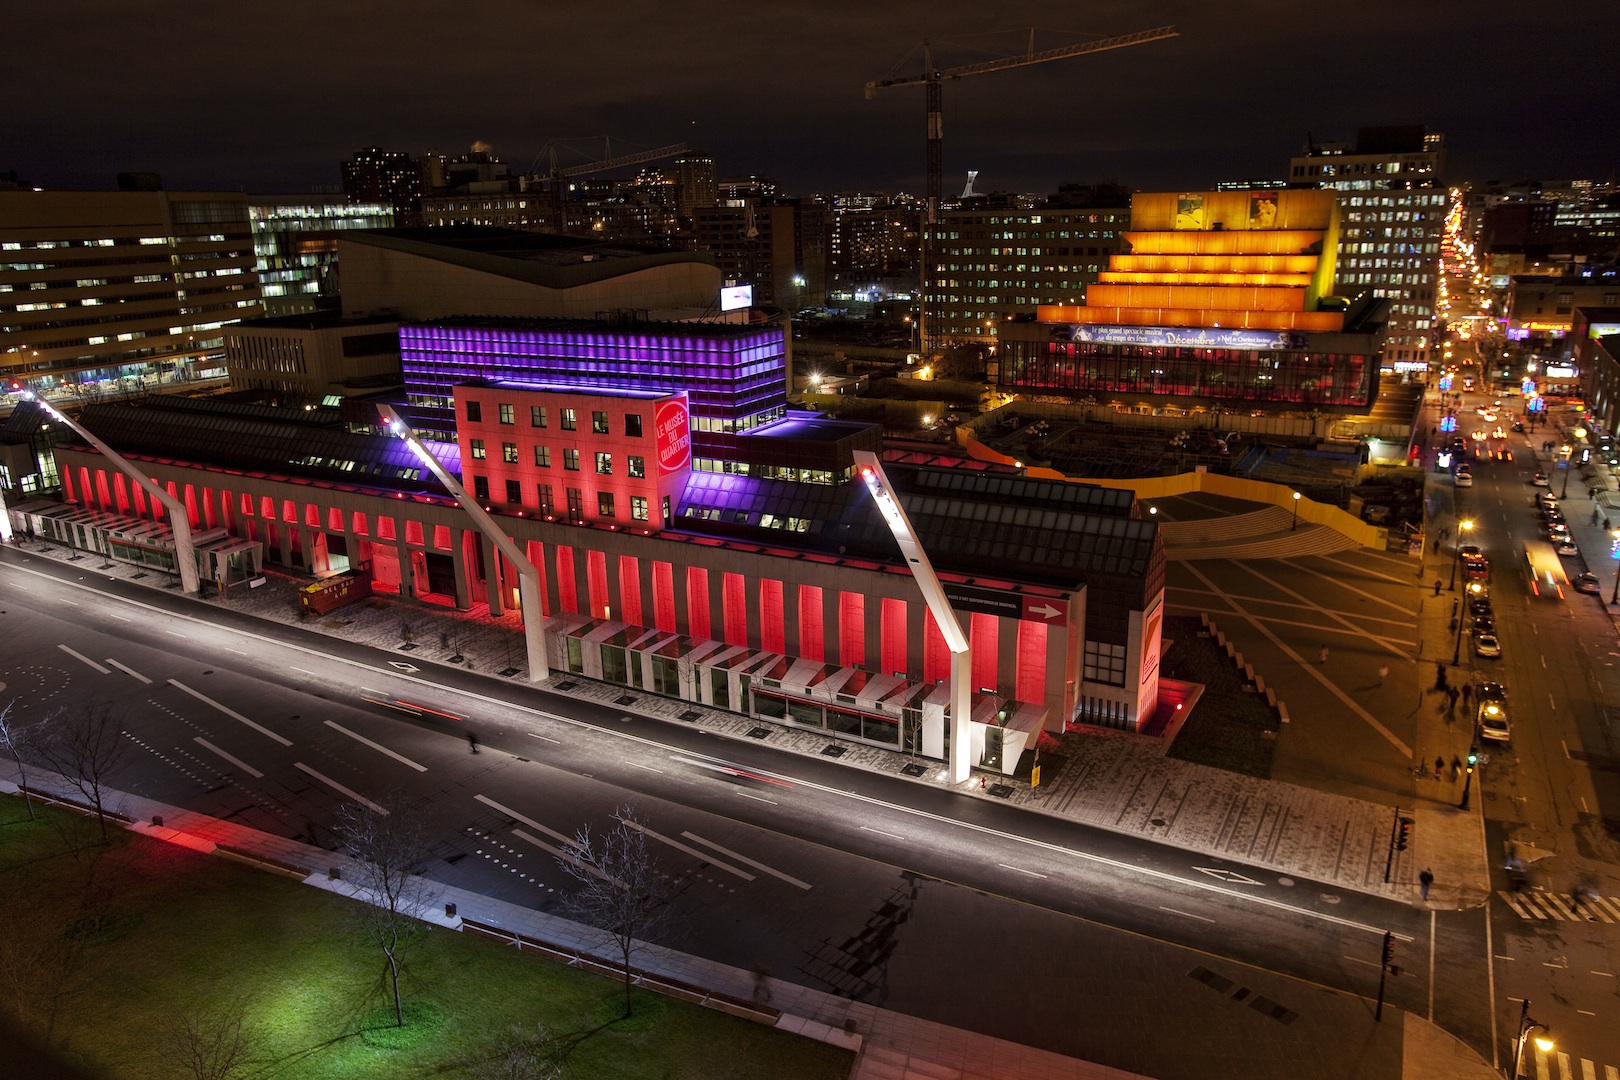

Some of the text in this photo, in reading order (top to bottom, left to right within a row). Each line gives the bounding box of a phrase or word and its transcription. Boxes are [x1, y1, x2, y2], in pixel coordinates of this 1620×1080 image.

[1098, 326, 1108, 334] plus
[1108, 327, 1122, 335] grand
[1166, 331, 1215, 345] Décembre
[656, 411, 685, 439] LE MUSÉE
[667, 430, 678, 444] DU
[660, 434, 690, 462] QUARTIER
